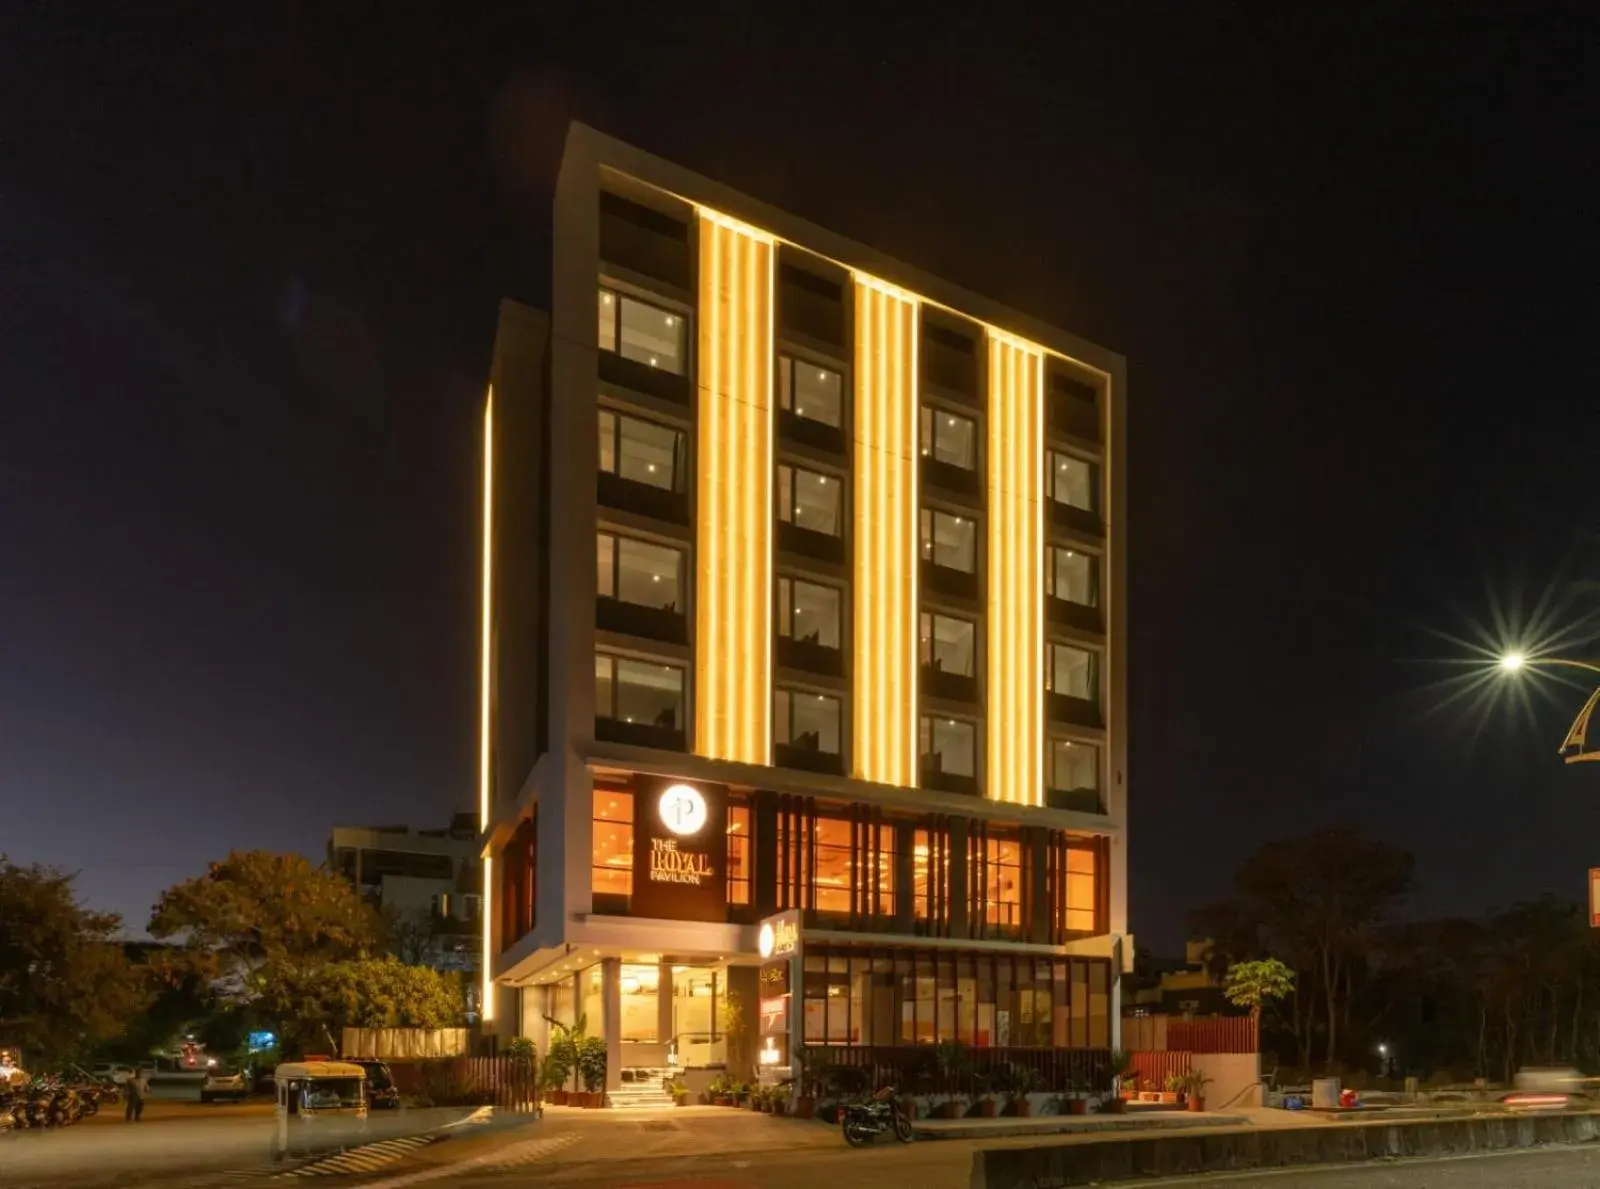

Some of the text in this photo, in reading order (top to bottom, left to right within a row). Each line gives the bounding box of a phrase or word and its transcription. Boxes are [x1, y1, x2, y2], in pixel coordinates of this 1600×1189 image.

[651, 838, 677, 852] THE
[651, 850, 713, 876] ROYAL
[650, 870, 700, 885] PAVILION
